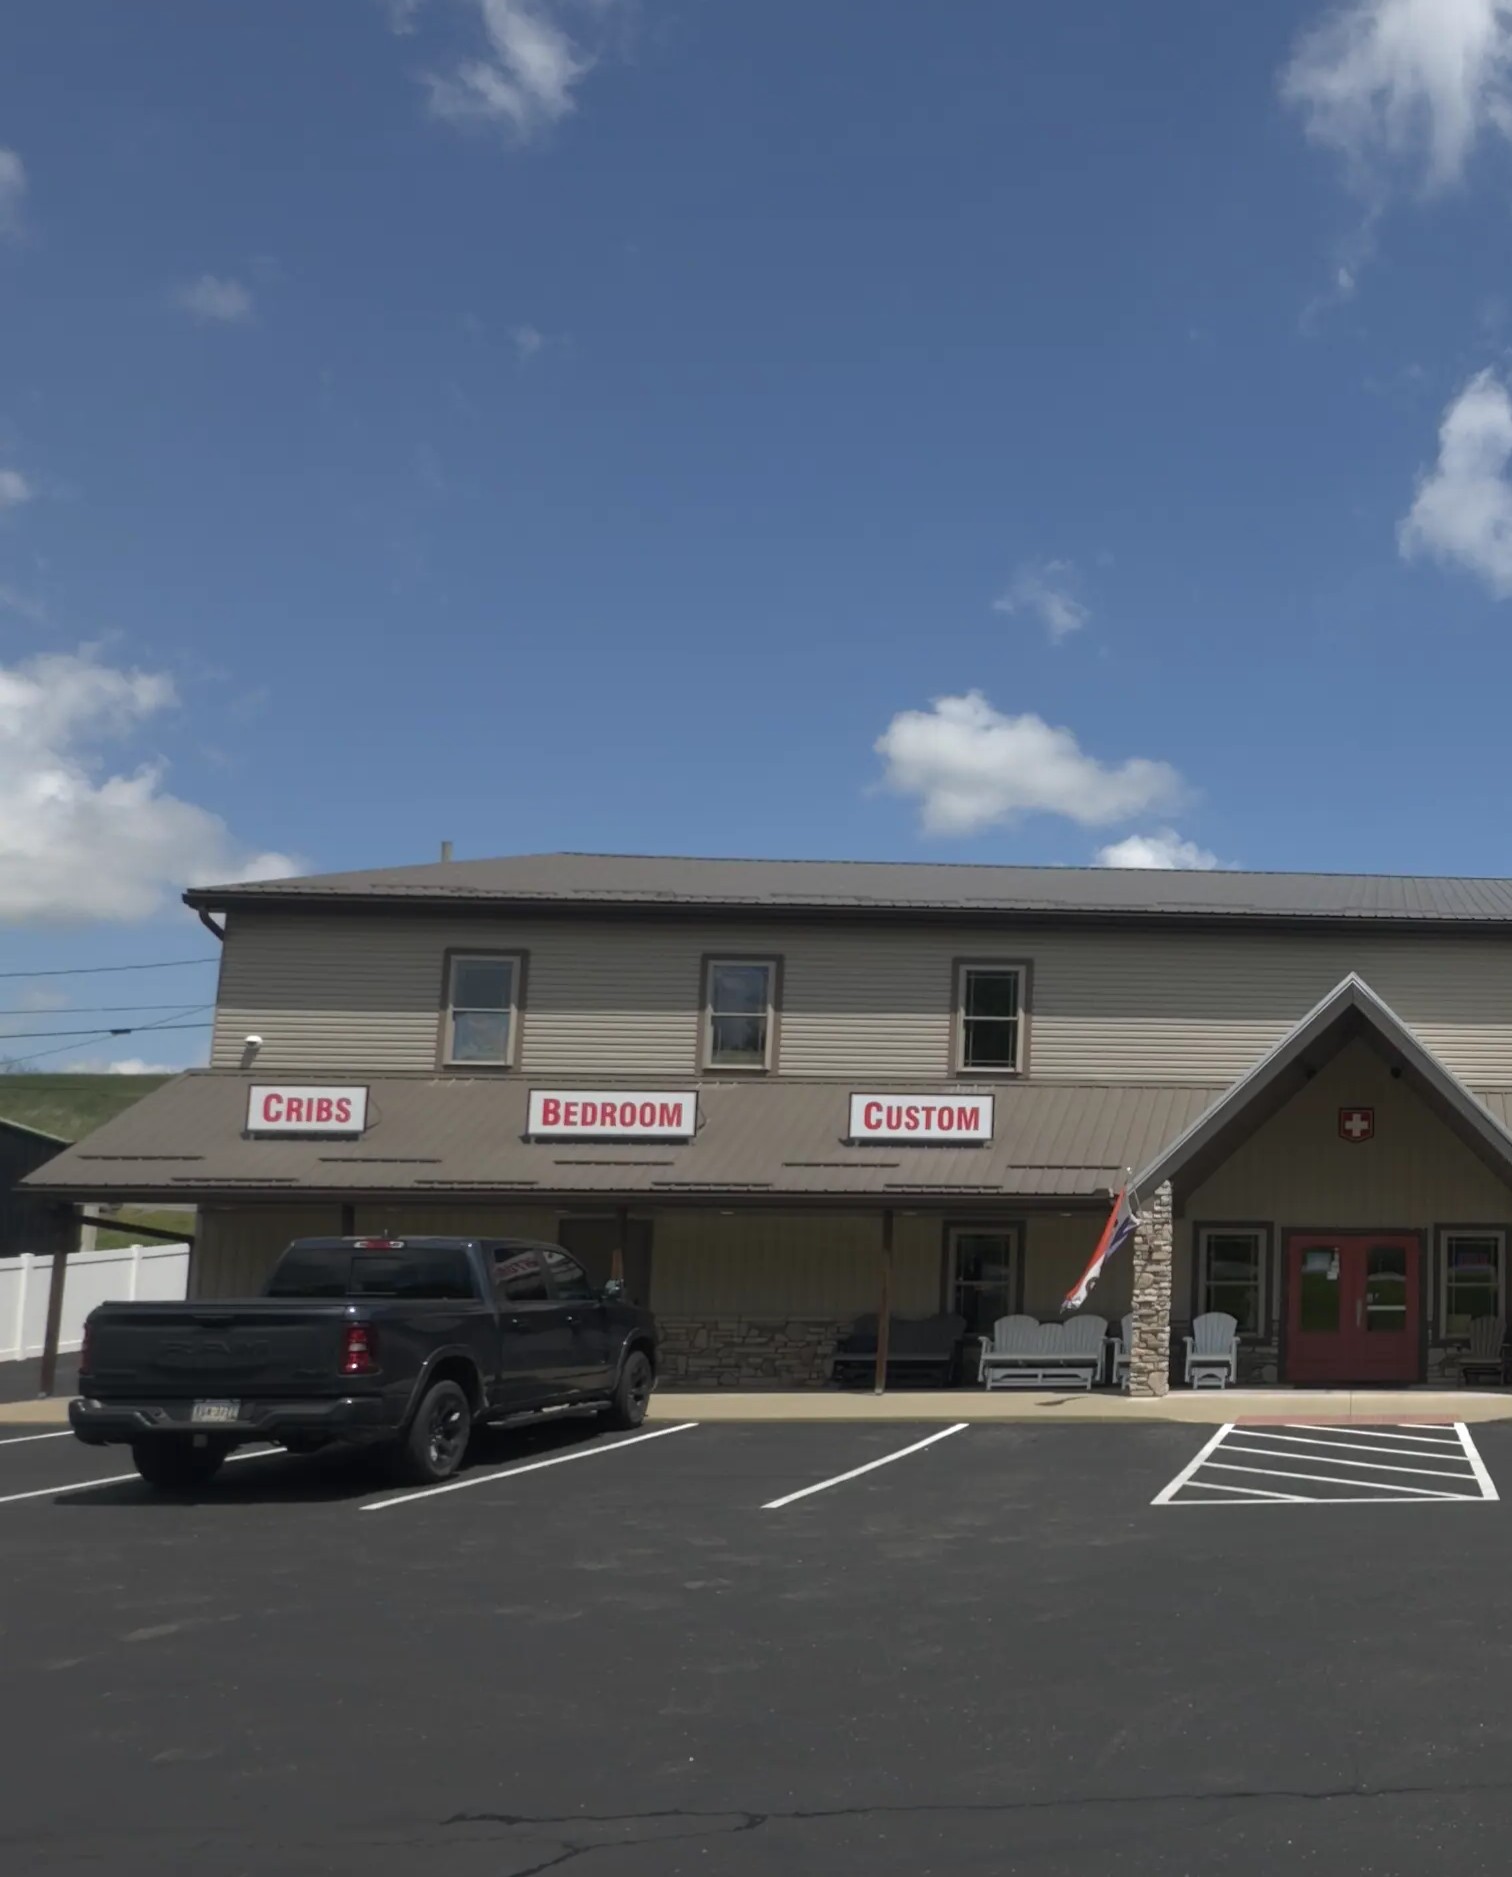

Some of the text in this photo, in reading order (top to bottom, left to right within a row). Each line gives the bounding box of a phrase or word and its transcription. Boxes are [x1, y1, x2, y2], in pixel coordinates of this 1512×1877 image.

[262, 1093, 352, 1123] CRIBS
[541, 1098, 683, 1128] BEDROOM
[864, 1101, 980, 1131] CUSTOM
